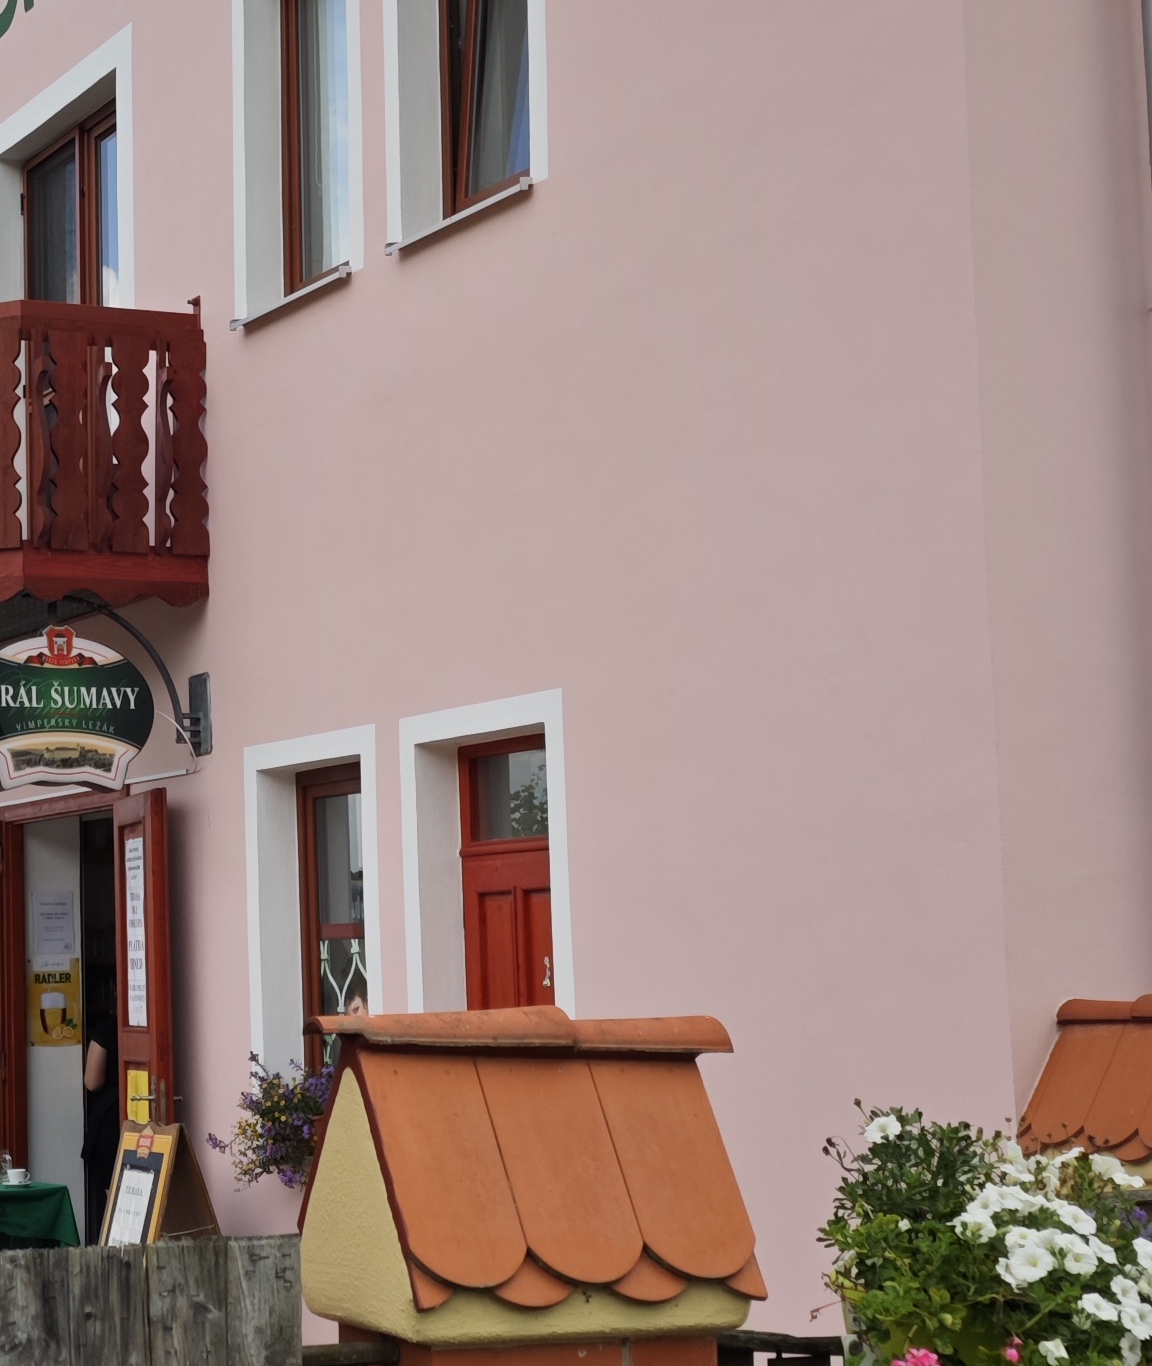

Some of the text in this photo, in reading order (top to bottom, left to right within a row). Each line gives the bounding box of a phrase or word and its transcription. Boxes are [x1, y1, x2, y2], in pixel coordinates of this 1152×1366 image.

[50, 680, 139, 710] ŠUMAVY
[15, 717, 78, 731] VIMPERSKÝ
[34, 972, 72, 985] RADLER
